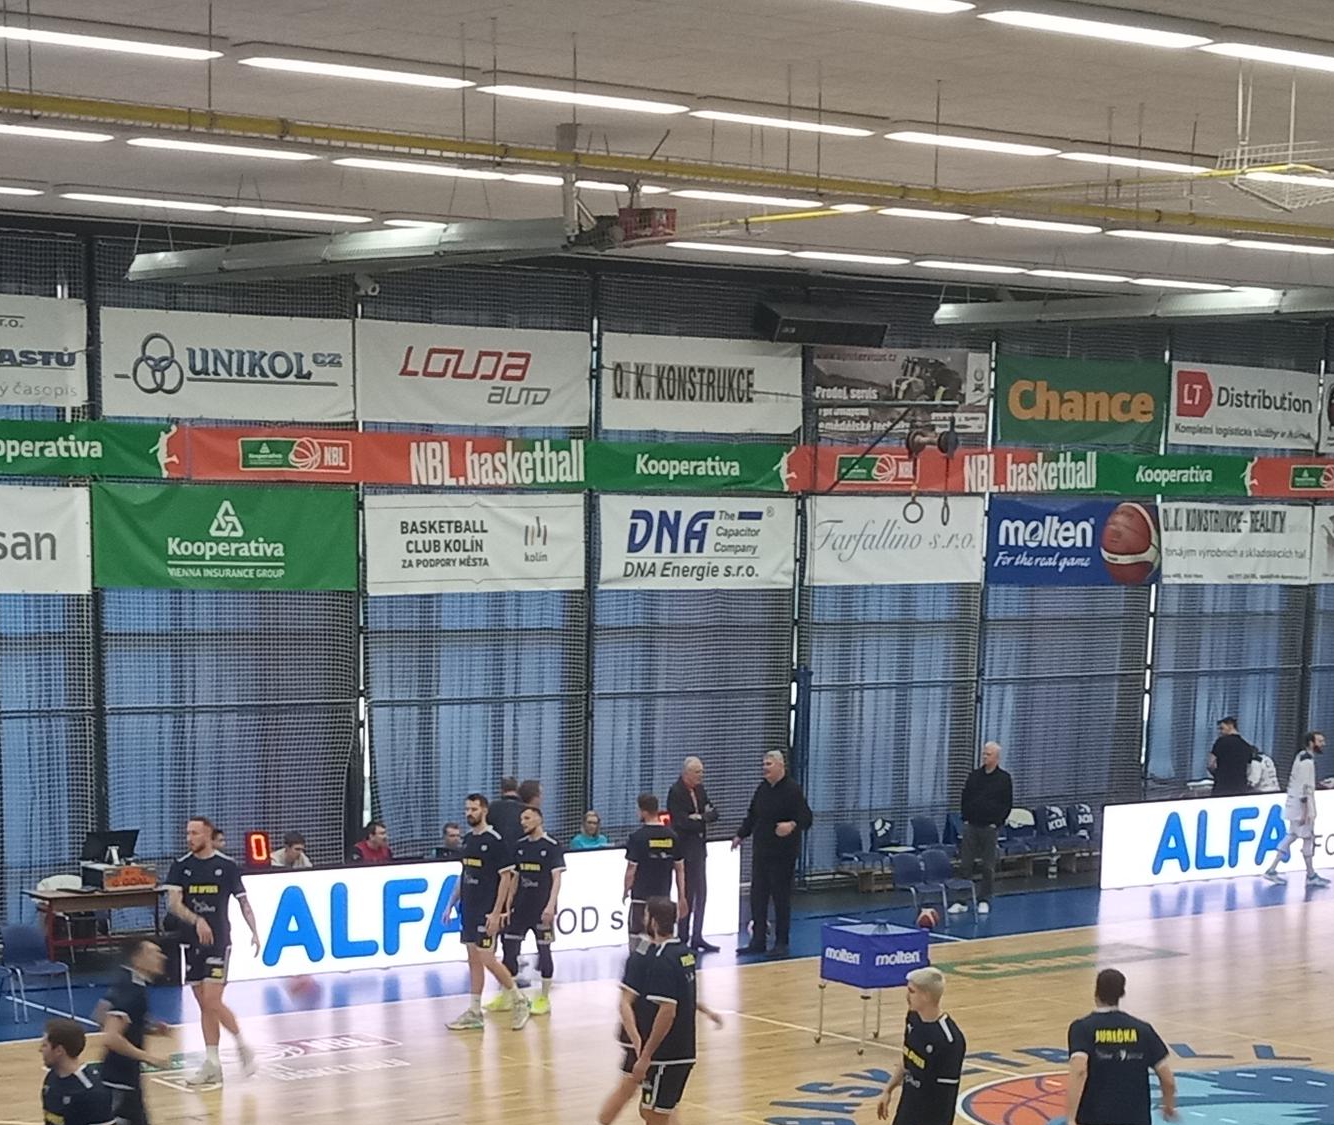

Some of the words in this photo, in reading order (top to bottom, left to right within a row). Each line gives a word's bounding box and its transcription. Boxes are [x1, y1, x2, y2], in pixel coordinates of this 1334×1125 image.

[186, 347, 313, 381] UNIKOL
[656, 365, 755, 402] KONSTRUKCE
[1008, 379, 1154, 423] Chance
[1182, 382, 1203, 406] LT
[1217, 387, 1313, 414] Distribution
[409, 439, 585, 486] NBL.basketball
[635, 453, 741, 479] Kooperativa
[965, 451, 1097, 493] NBL.basketball
[1135, 463, 1213, 486] Kooperativa
[399, 519, 489, 536] BASKETBALL
[626, 509, 715, 555] DNA
[718, 510, 736, 521] The
[716, 525, 761, 540] Capacitor
[814, 518, 921, 562] Farfallino
[999, 515, 1093, 548] molten
[168, 536, 285, 560] Kooperativa
[405, 537, 440, 554] CLUB
[443, 534, 484, 554] KOLÍN
[713, 541, 758, 557] Company
[168, 567, 202, 577] VIENNA
[203, 568, 254, 578] INSURANCE
[255, 568, 285, 579] GROUP
[401, 558, 413, 569] ZA
[415, 557, 456, 569] PODPORY
[458, 554, 490, 568] MĚSTA
[622, 561, 658, 579] DNA
[660, 561, 720, 582] Energie
[723, 563, 760, 579] s.r.o.
[993, 551, 1011, 568] For
[1014, 551, 1032, 566] the
[1034, 552, 1057, 567] real
[1059, 557, 1091, 572] game
[1151, 803, 1292, 876] ALFA
[824, 943, 861, 965] molten
[875, 947, 921, 970] molten
